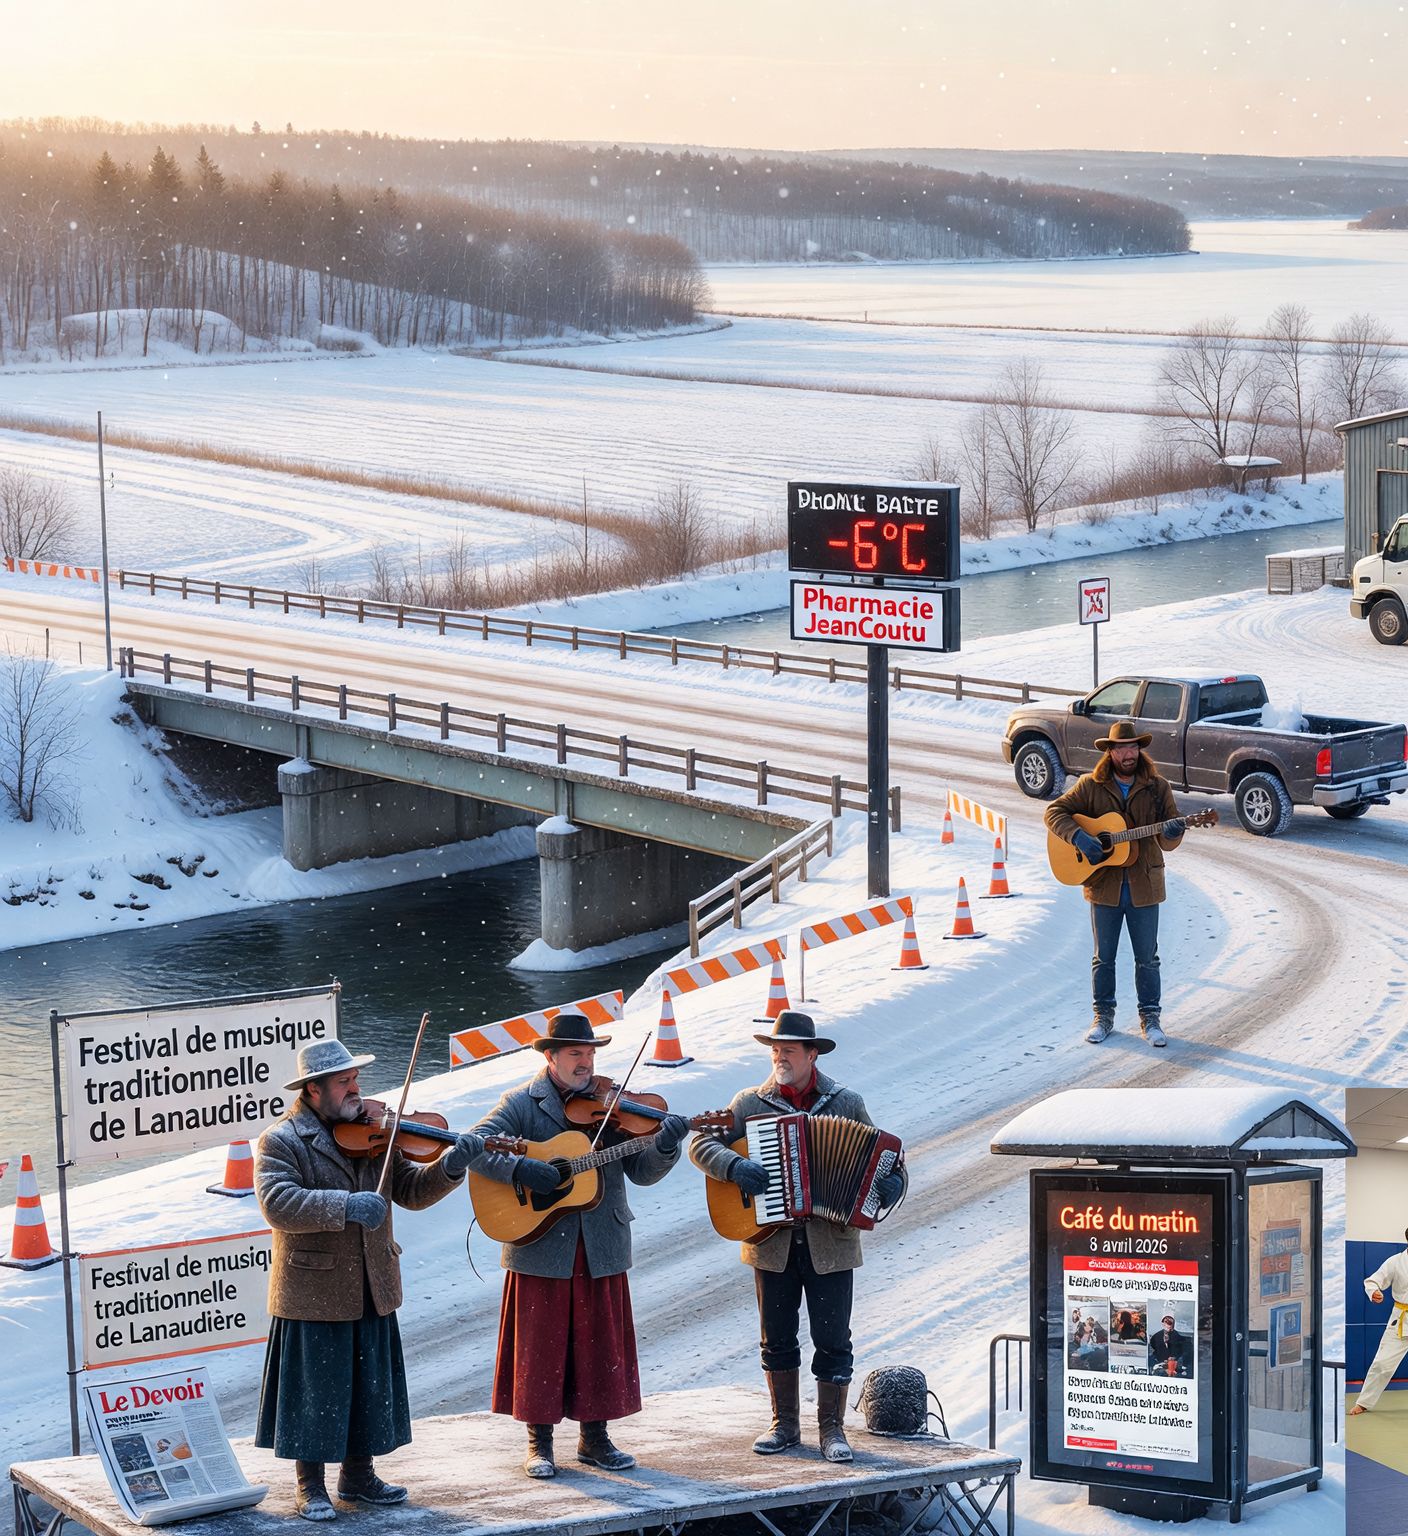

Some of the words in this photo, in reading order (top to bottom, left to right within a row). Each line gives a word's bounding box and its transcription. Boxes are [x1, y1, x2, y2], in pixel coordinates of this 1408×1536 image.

[828, 520, 926, 571] -6°C
[803, 588, 934, 619] Pharmacie
[804, 612, 926, 642] JeanCoutu
[79, 1028, 179, 1067] Festival
[186, 1025, 217, 1054] de
[224, 1017, 326, 1049] musique
[84, 1056, 270, 1105] traditionnelle
[90, 1111, 126, 1142] de
[135, 1093, 285, 1136] Lanaudière
[1060, 1205, 1104, 1230] Café
[1109, 1206, 1134, 1230] du
[1139, 1209, 1198, 1233] matin
[1102, 1237, 1132, 1254] avril
[1136, 1238, 1168, 1255] 2026
[91, 1257, 170, 1290] Festival
[176, 1254, 202, 1278] de
[208, 1246, 272, 1273] musiq
[94, 1279, 237, 1320] traditionnelle
[95, 1326, 123, 1349] de
[130, 1309, 246, 1344] Lanaudière
[98, 1391, 129, 1414] Le
[130, 1377, 205, 1409] Devoir
